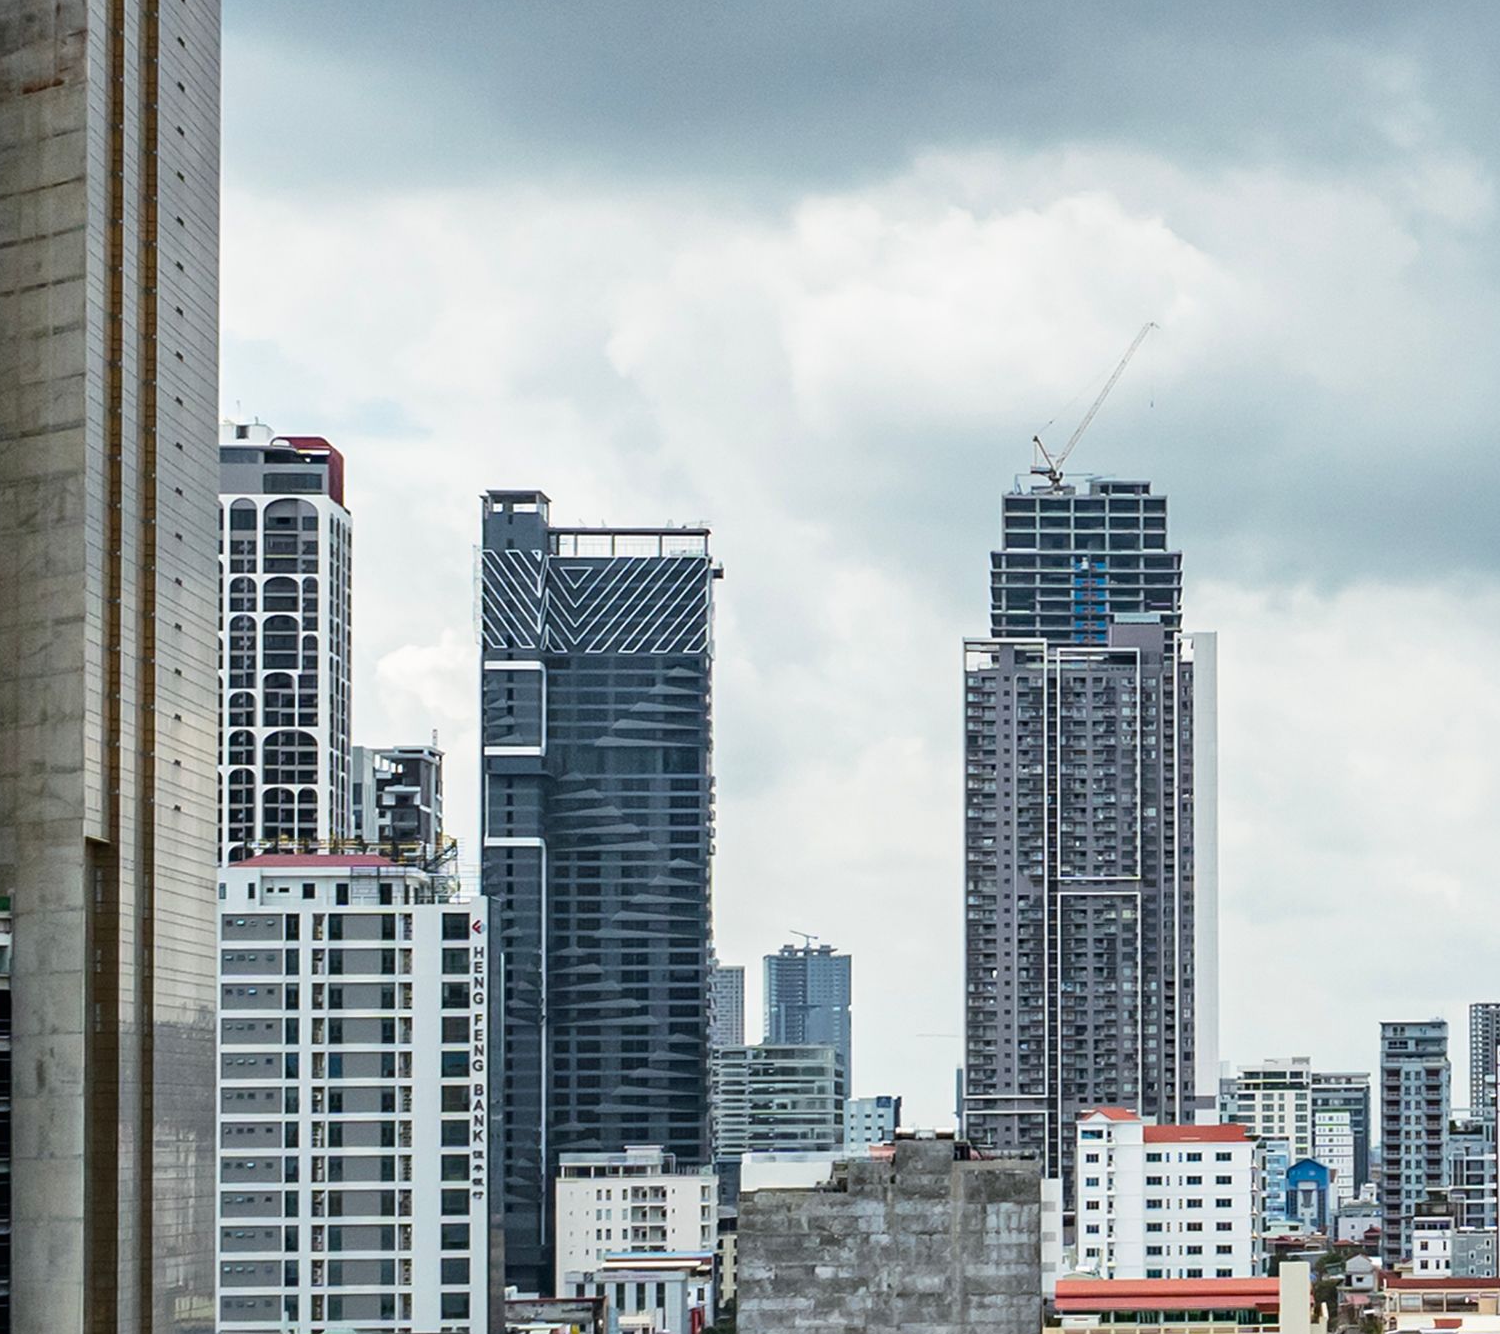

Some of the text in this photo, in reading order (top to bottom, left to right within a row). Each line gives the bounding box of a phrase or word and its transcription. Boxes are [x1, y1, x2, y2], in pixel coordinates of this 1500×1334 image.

[473, 946, 484, 1142] HENG FENG BANK
